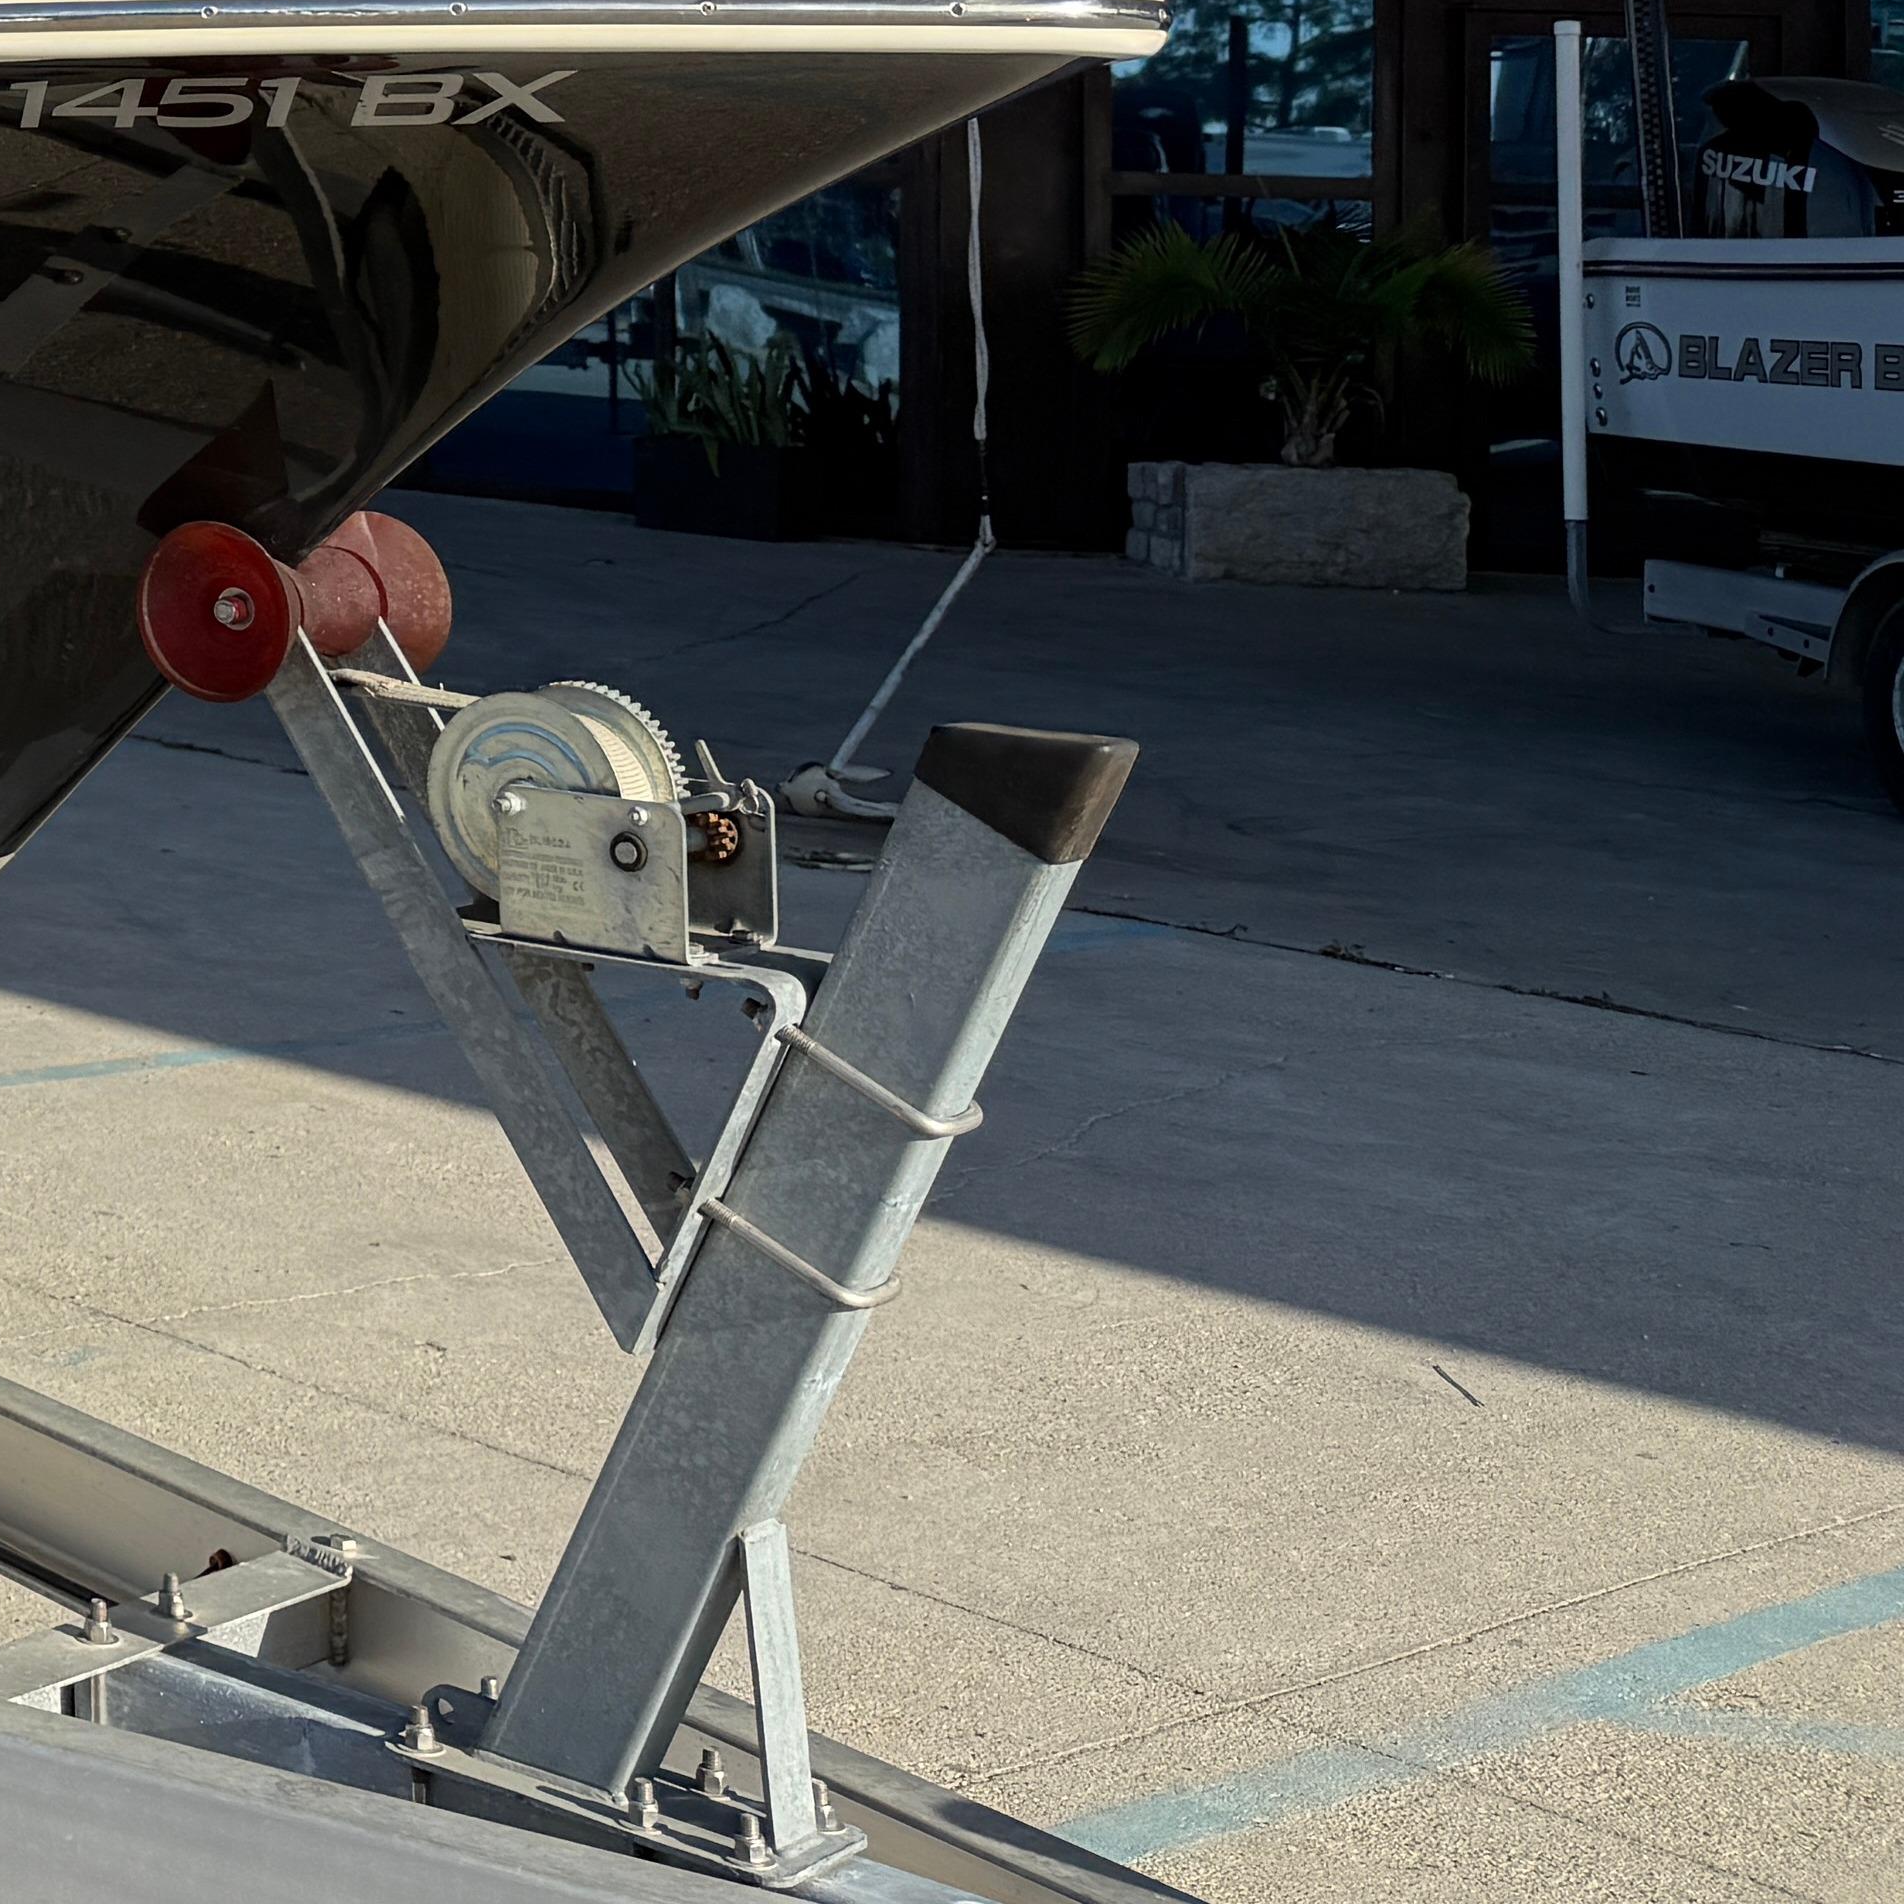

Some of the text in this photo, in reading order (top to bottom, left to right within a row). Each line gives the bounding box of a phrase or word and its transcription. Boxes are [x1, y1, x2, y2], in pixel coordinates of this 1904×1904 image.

[9, 77, 301, 128] 1451
[351, 70, 578, 127] BX
[1702, 149, 1817, 193] SUZUKI
[1678, 335, 1863, 389] BLAZER
